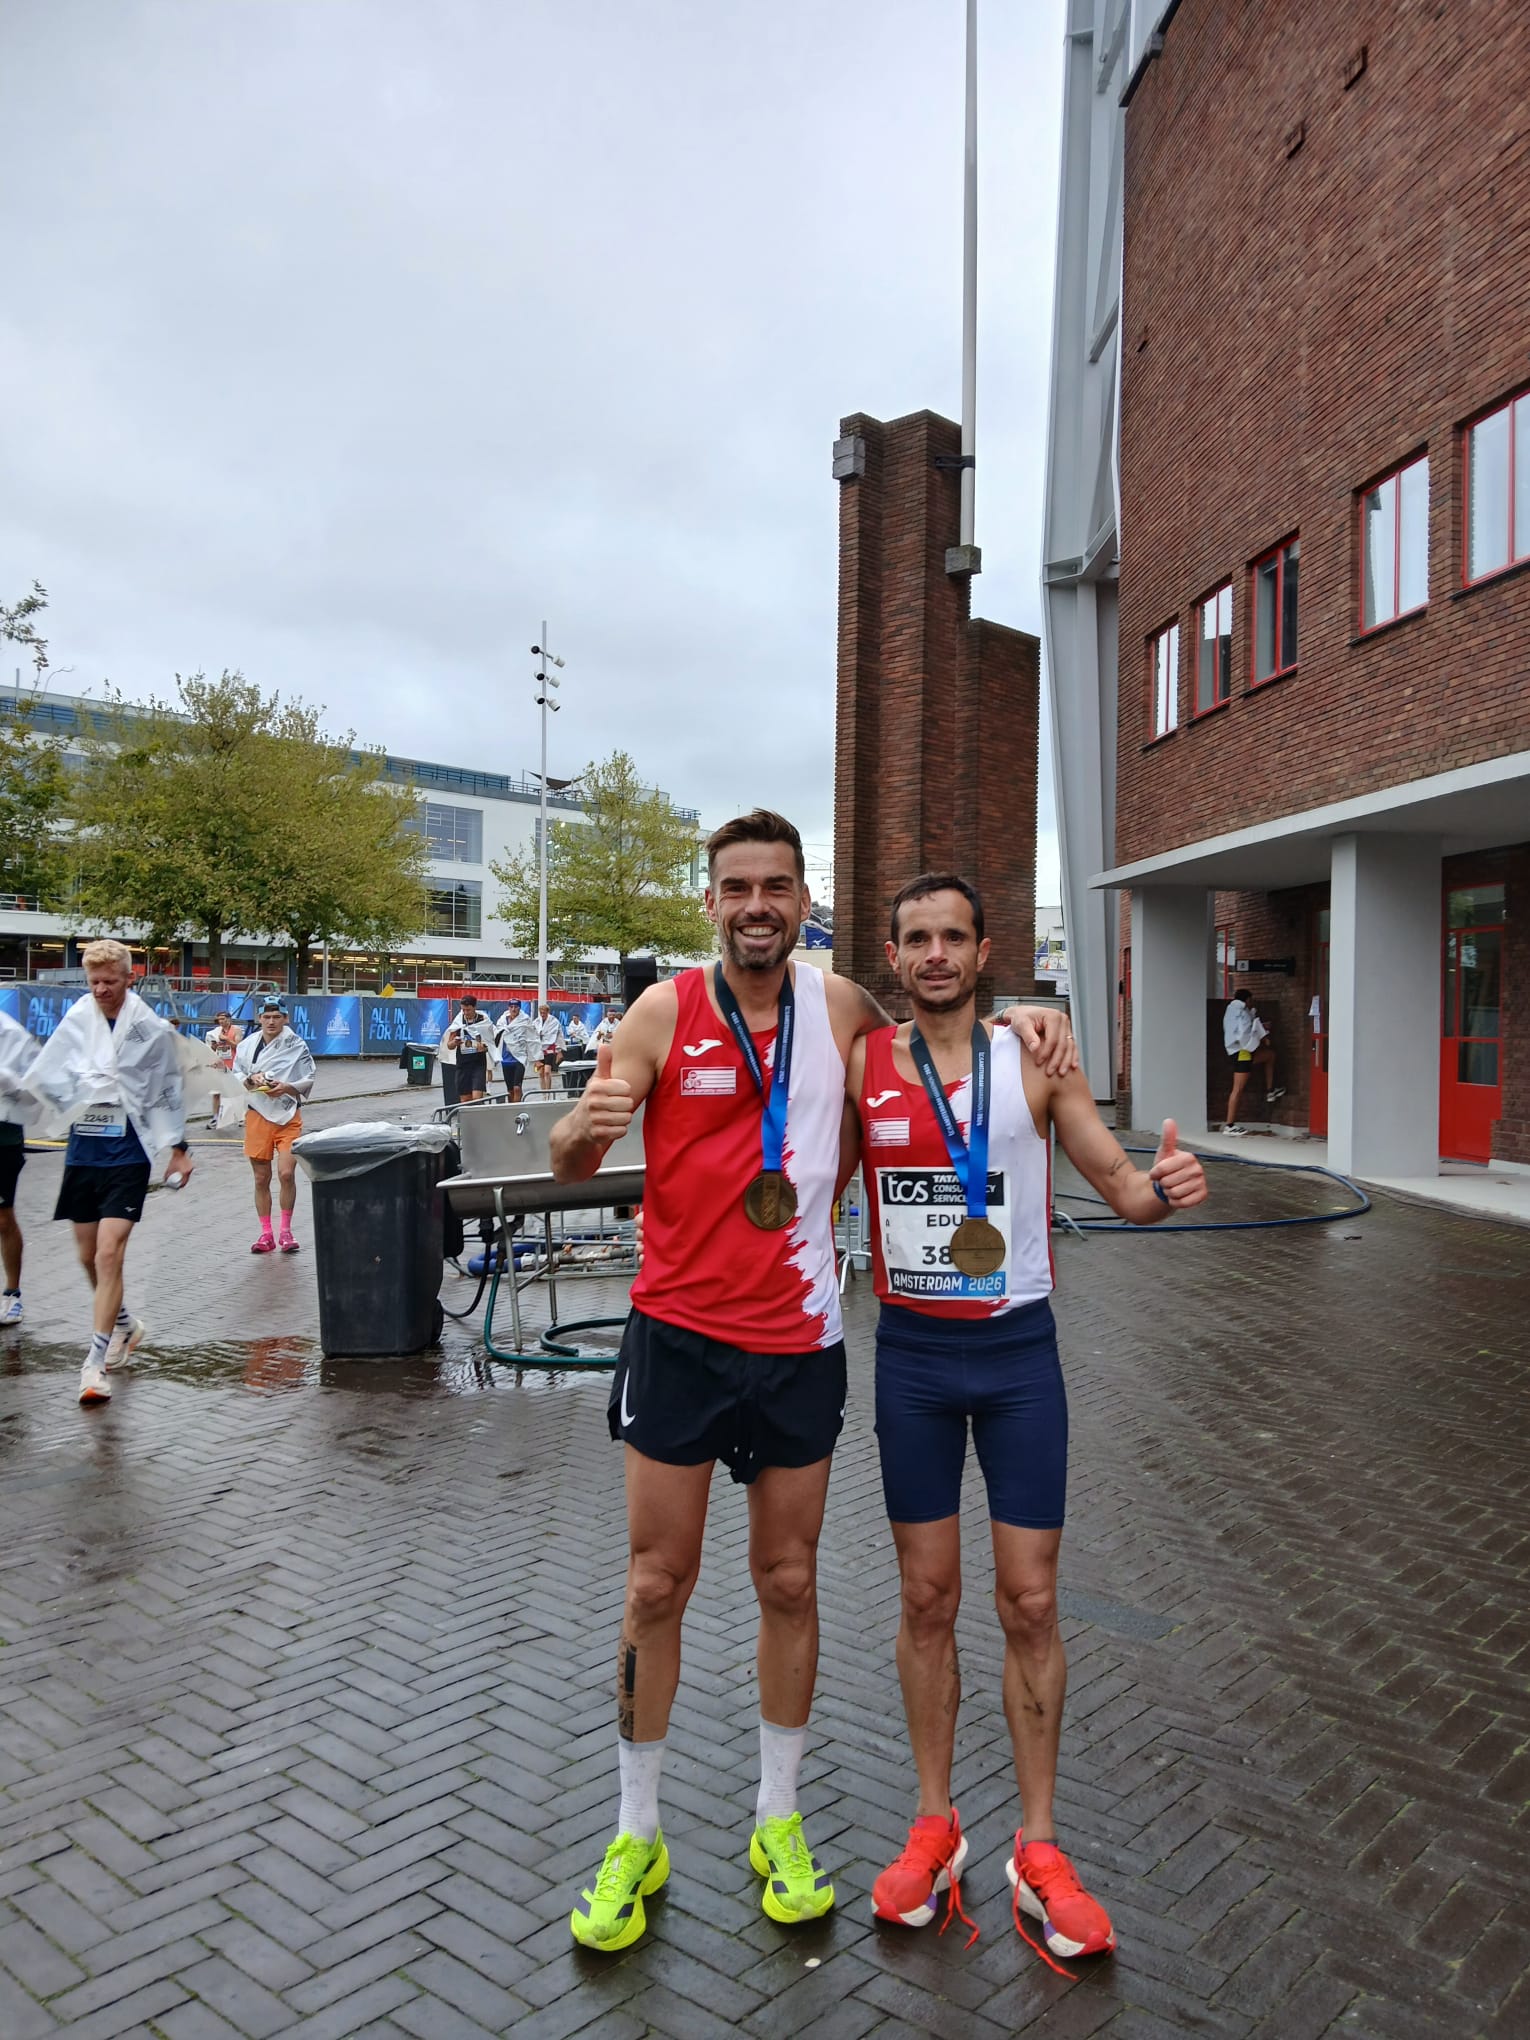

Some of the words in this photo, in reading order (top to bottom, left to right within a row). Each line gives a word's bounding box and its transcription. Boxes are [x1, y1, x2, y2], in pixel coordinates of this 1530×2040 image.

[371, 1007, 391, 1024] ALL
[369, 1023, 392, 1040] FOR
[394, 1023, 413, 1040] ALL
[932, 1175, 960, 1183] TATA
[887, 1174, 928, 1203] tcs
[926, 1213, 964, 1228] EDU
[922, 1246, 953, 1265] 38
[893, 1272, 964, 1291] AMSTERDAM
[968, 1276, 1003, 1291] 2026
